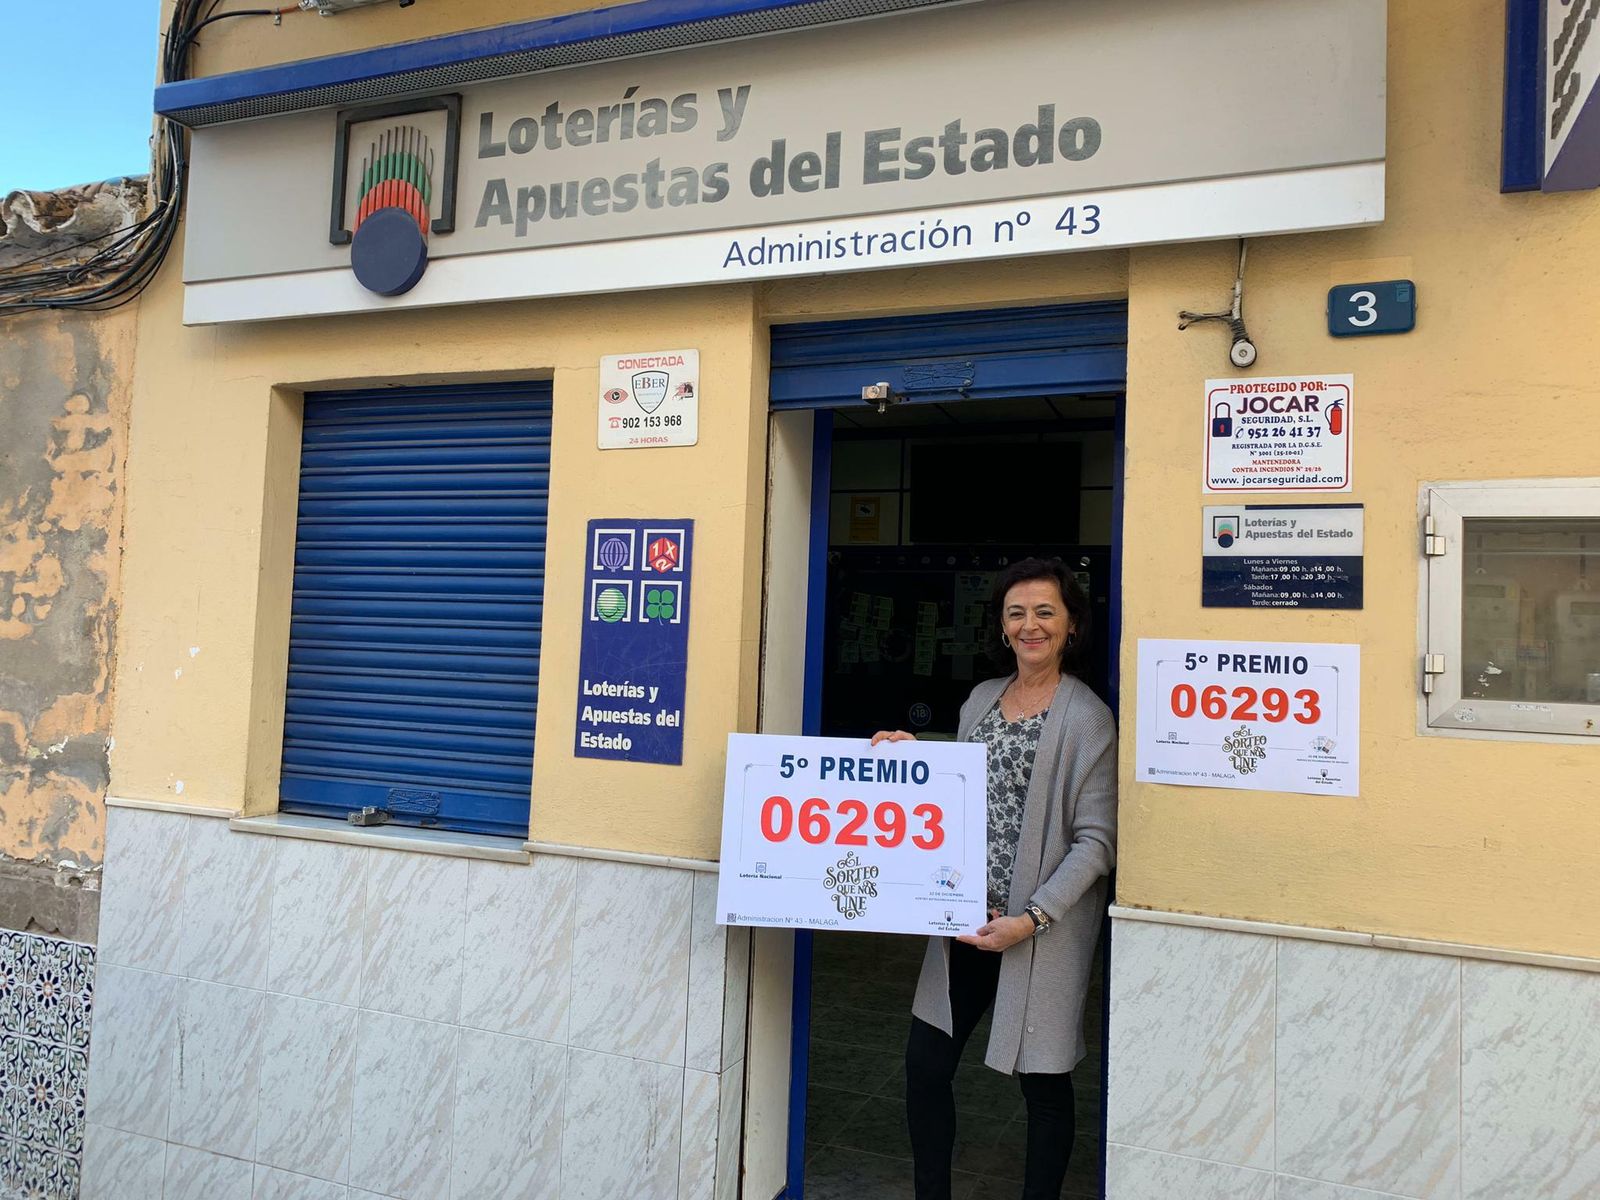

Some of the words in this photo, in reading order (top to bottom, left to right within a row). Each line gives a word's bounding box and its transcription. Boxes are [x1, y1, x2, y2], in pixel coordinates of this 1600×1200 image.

[478, 86, 698, 159] Loterías
[716, 85, 751, 142] y
[474, 158, 730, 237] Apuestas
[749, 131, 842, 198] del
[863, 103, 1102, 185] Estado
[722, 219, 972, 268] Administración
[1055, 204, 1101, 236] 43
[1348, 290, 1378, 327] 3
[617, 355, 685, 370] CONECTADA
[634, 377, 666, 389] EBER
[1229, 382, 1297, 394] PROTEGIDO
[1300, 381, 1328, 392] POR:
[1236, 395, 1320, 415] JOCAR
[622, 417, 640, 428] 902
[643, 416, 661, 427] 153
[664, 415, 682, 427] 968
[1241, 415, 1296, 425] SEGURIDAD,
[1298, 415, 1314, 423] S.L.
[640, 436, 669, 444] HORAS
[1247, 426, 1269, 439] 952
[1271, 426, 1286, 437] 26
[1288, 426, 1303, 438] 41
[1306, 426, 1321, 438] 37
[1211, 476, 1239, 484] www.
[1242, 474, 1343, 486] jocarseguridad.com
[1244, 518, 1288, 527] Loterías
[1290, 520, 1297, 528] y
[1245, 529, 1294, 540] Apuestas
[1297, 529, 1313, 539] del
[1316, 529, 1354, 539] Estado
[1217, 653, 1309, 675] PREMIO
[583, 679, 645, 698] Loterías
[648, 686, 659, 704] y
[1170, 683, 1322, 725] 06293
[581, 705, 652, 726] Apuestas
[655, 709, 680, 727] del
[580, 731, 632, 751] Estado
[1221, 735, 1267, 753] SORTEO
[1232, 748, 1248, 758] QUE
[819, 756, 930, 785] PREMIO
[760, 795, 945, 850] 06293
[836, 850, 862, 869] EL
[823, 865, 879, 890] SORTEO
[836, 884, 856, 896] QUE
[857, 880, 878, 898] NOS
[831, 894, 867, 920] UNE
